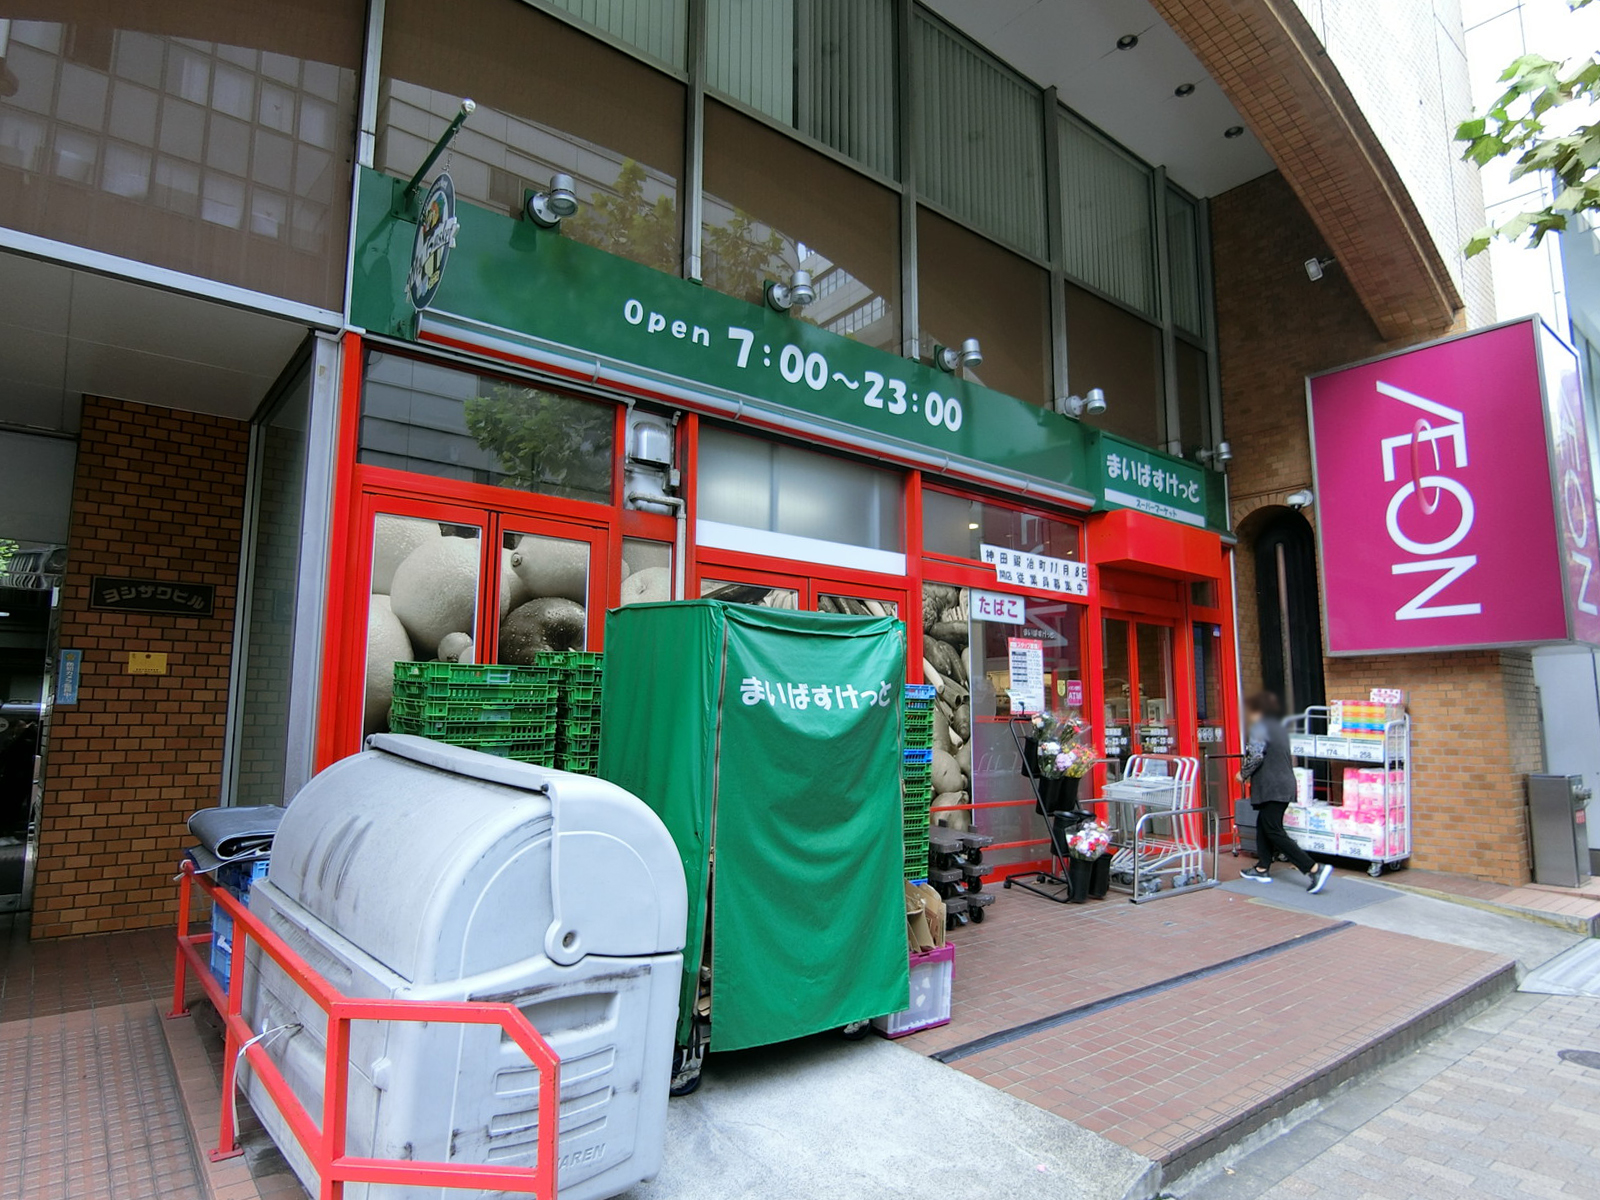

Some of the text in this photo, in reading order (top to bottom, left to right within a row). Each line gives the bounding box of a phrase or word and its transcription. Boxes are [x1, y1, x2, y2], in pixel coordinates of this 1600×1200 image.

[623, 298, 711, 347] Open
[1106, 453, 1200, 503] まいばすけっと
[1136, 499, 1178, 518] スーパーマーケット
[978, 596, 1018, 618] たばこ
[739, 676, 892, 711] まいばすけっと
[1068, 691, 1082, 700] ATM
